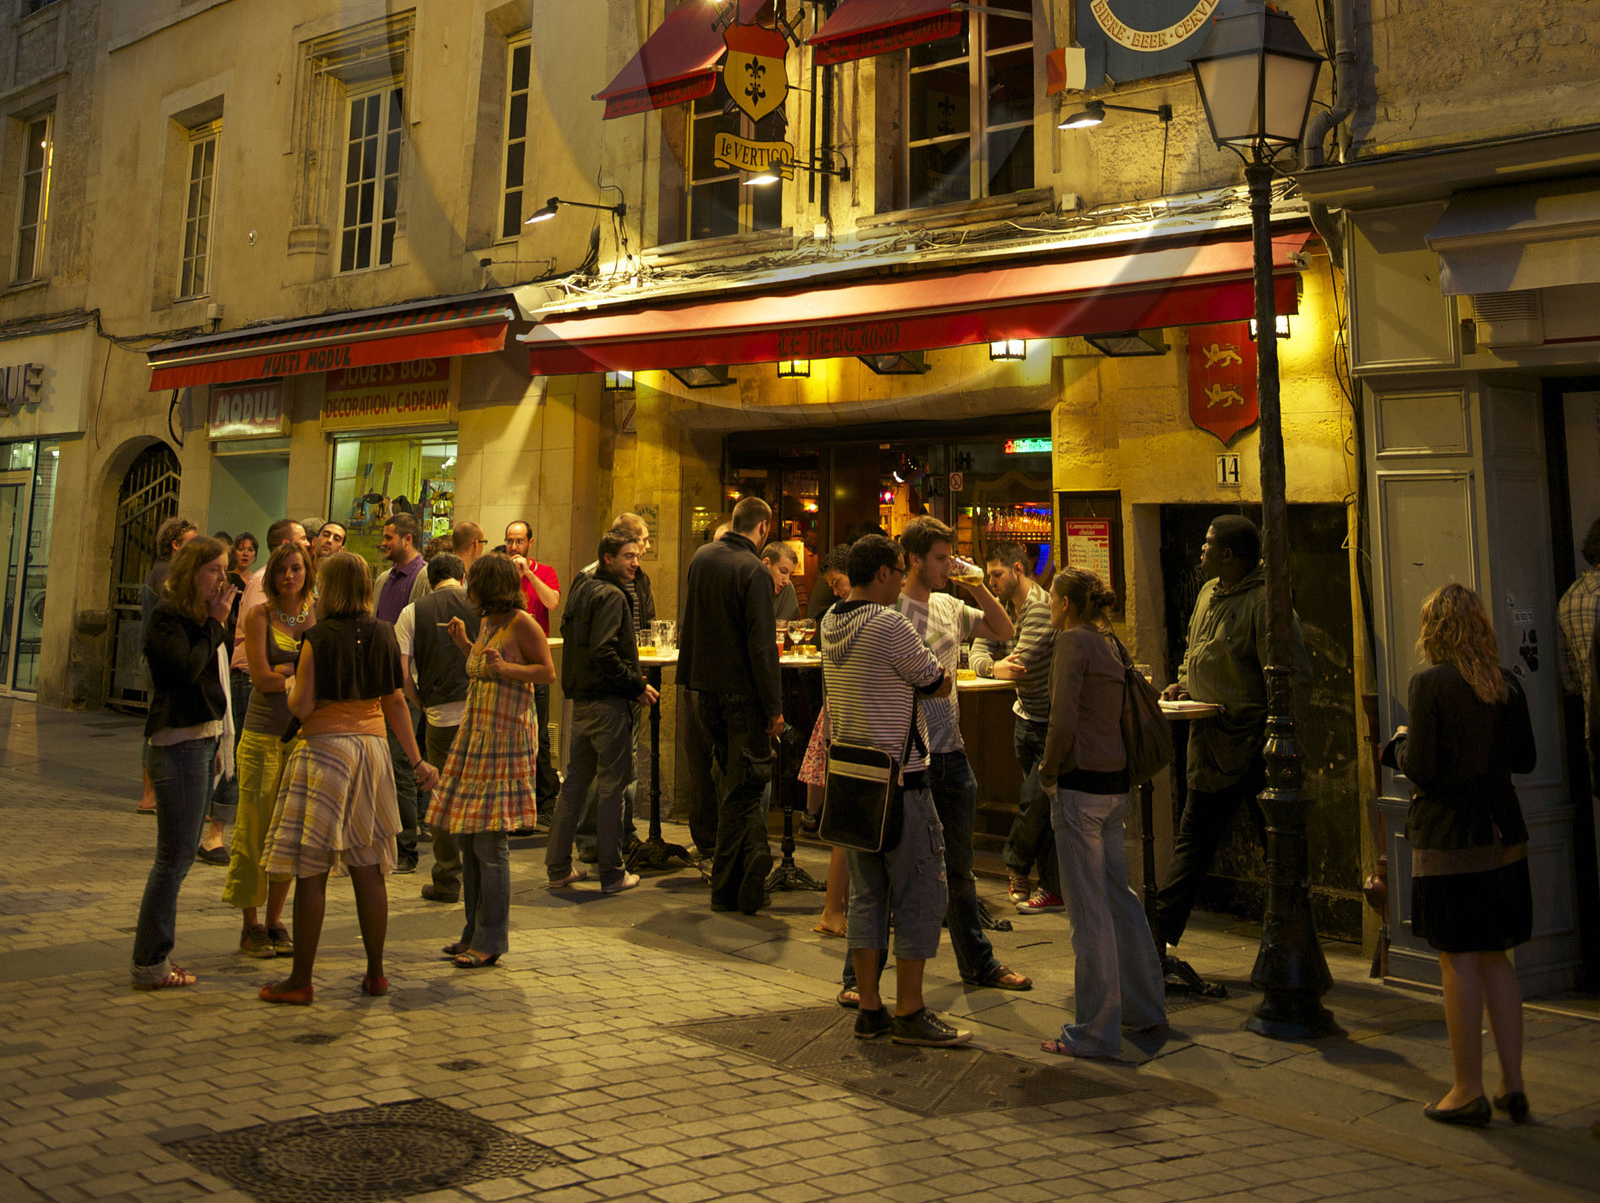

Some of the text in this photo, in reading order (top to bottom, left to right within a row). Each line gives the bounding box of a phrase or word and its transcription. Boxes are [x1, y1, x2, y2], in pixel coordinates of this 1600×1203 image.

[1093, 0, 1126, 41] BIERE
[1131, 32, 1168, 49] BEER
[734, 141, 789, 167] VERTIGO
[778, 323, 899, 357] LE VERTIGO
[262, 347, 351, 375] MULTI MODUL
[340, 358, 437, 386] JOUETS BOIS
[215, 389, 278, 426] MODUL
[396, 388, 449, 413] CADEAUX
[1218, 457, 1240, 483] 14
